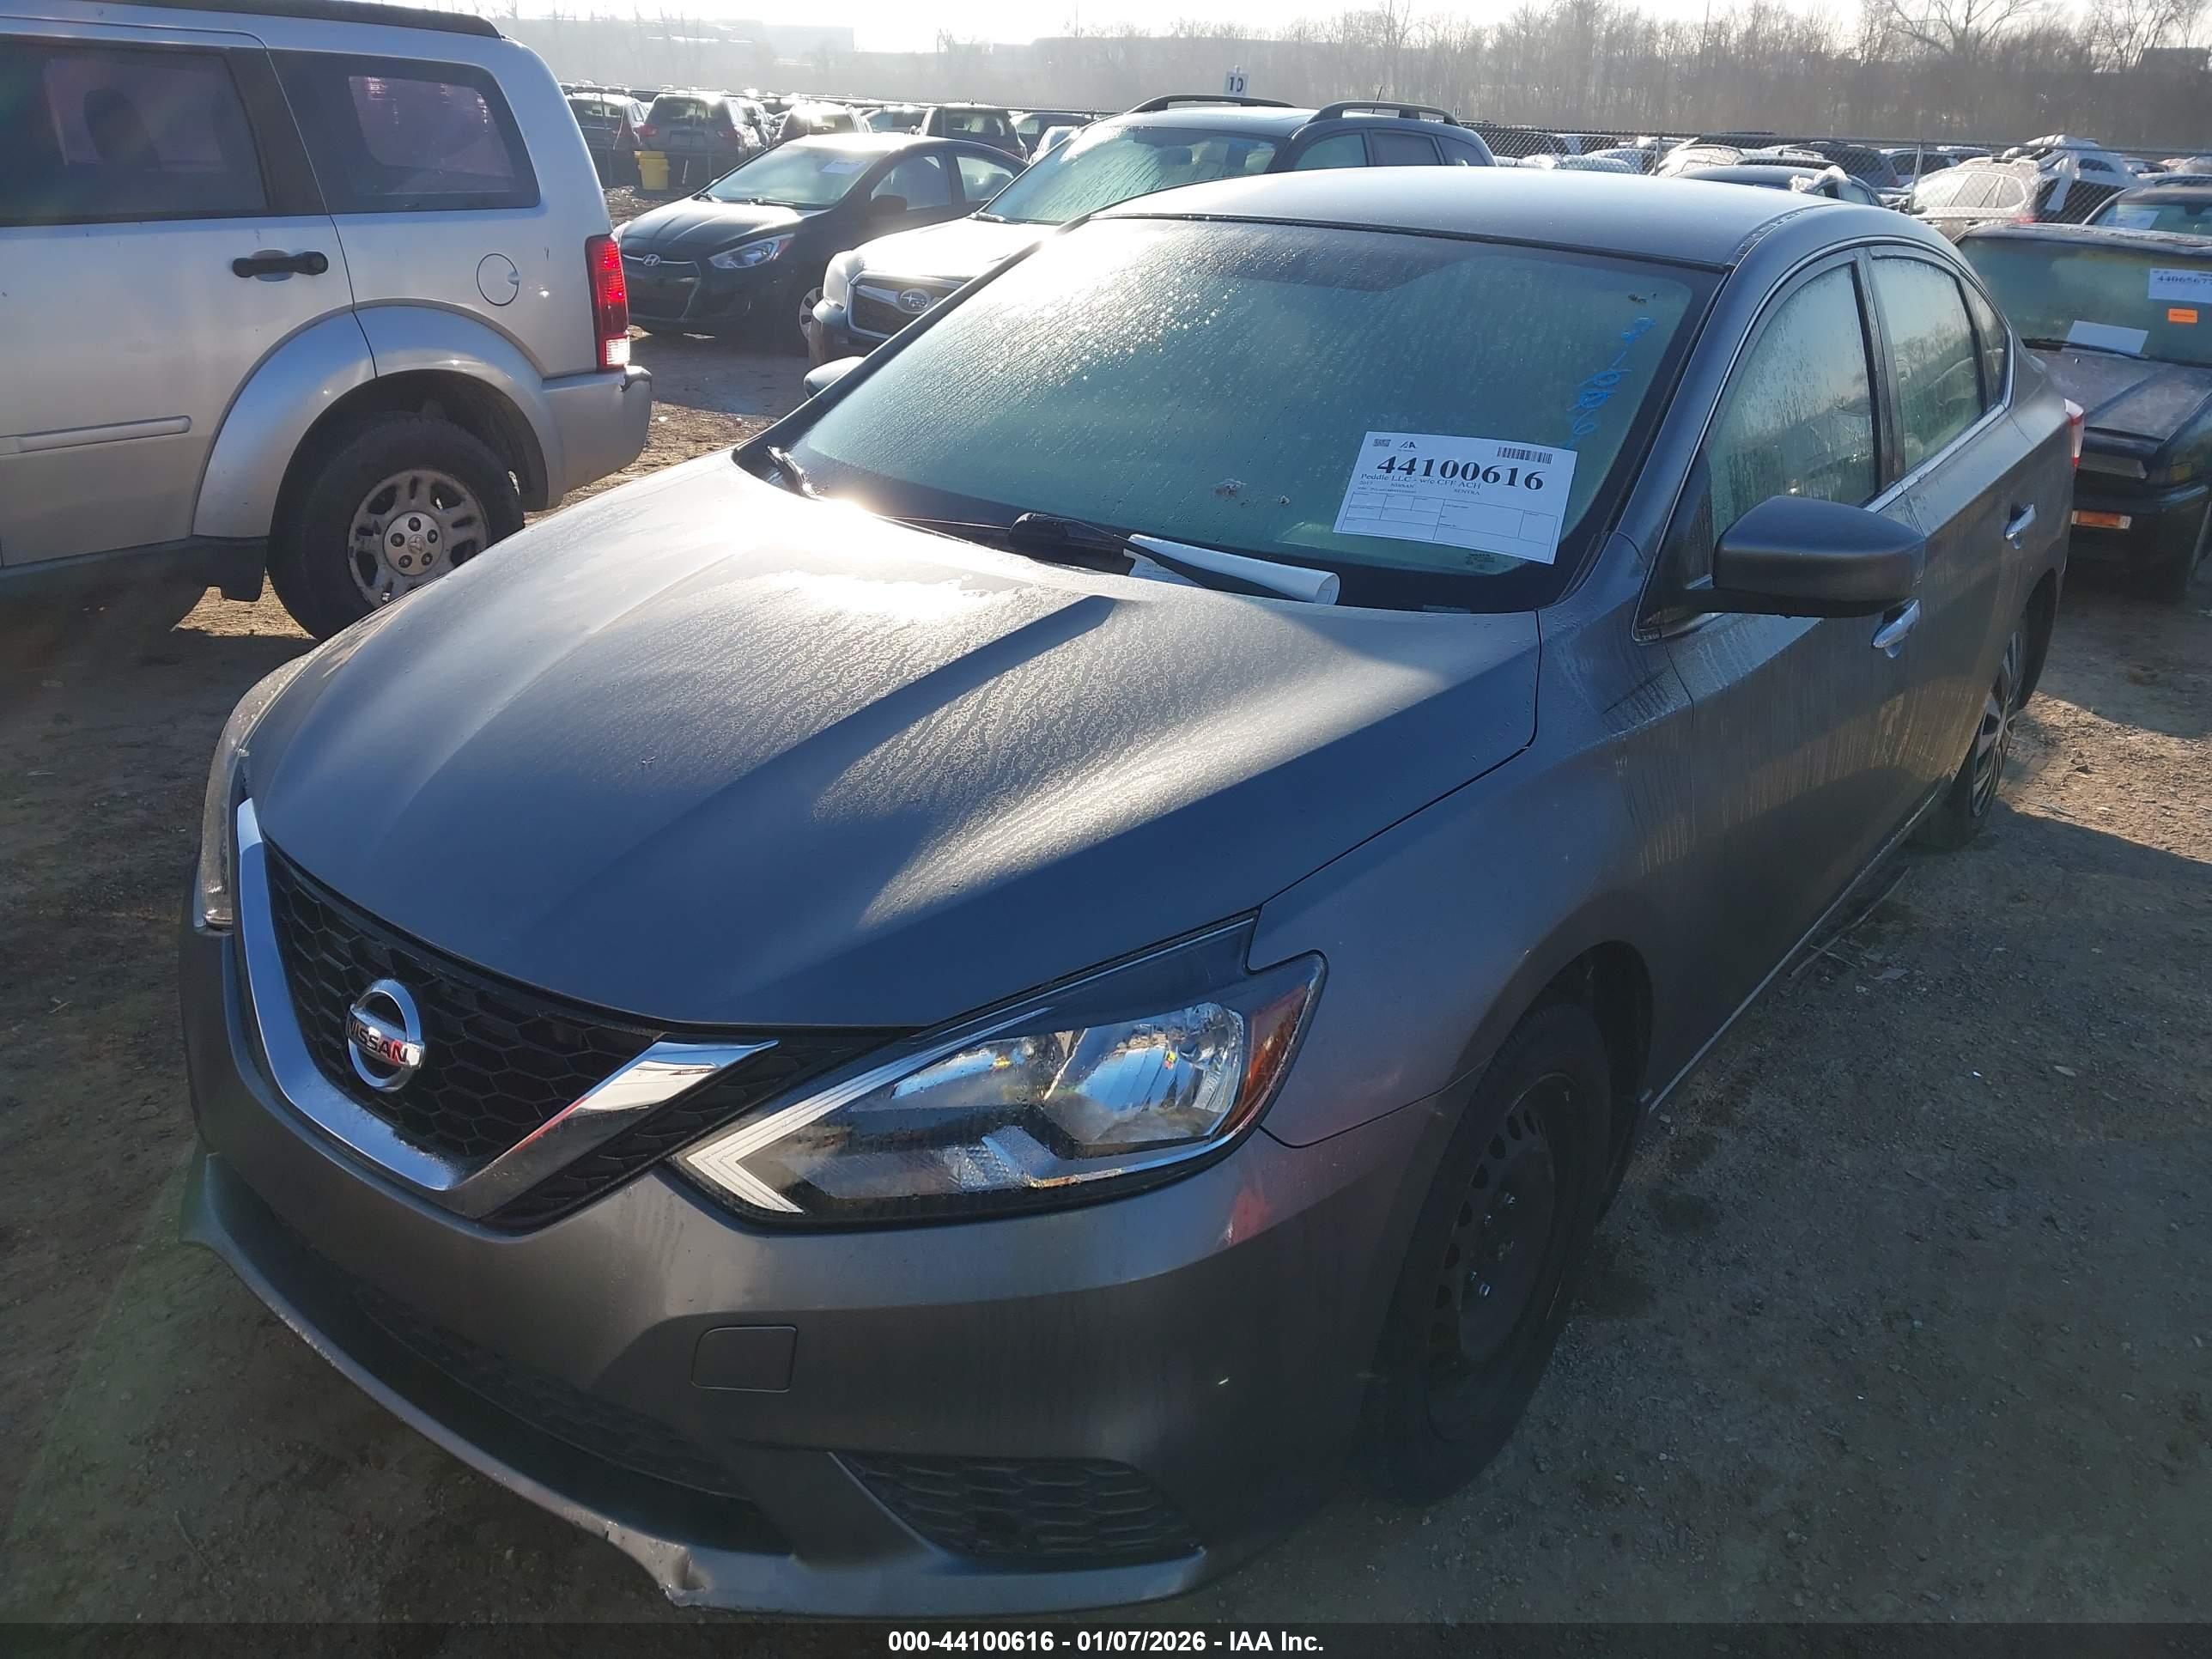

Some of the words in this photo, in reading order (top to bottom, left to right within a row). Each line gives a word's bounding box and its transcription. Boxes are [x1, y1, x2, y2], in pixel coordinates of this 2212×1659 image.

[1376, 455, 1547, 490] 44100616
[1458, 481, 1481, 489] ACH
[349, 1020, 409, 1063] NISSAN
